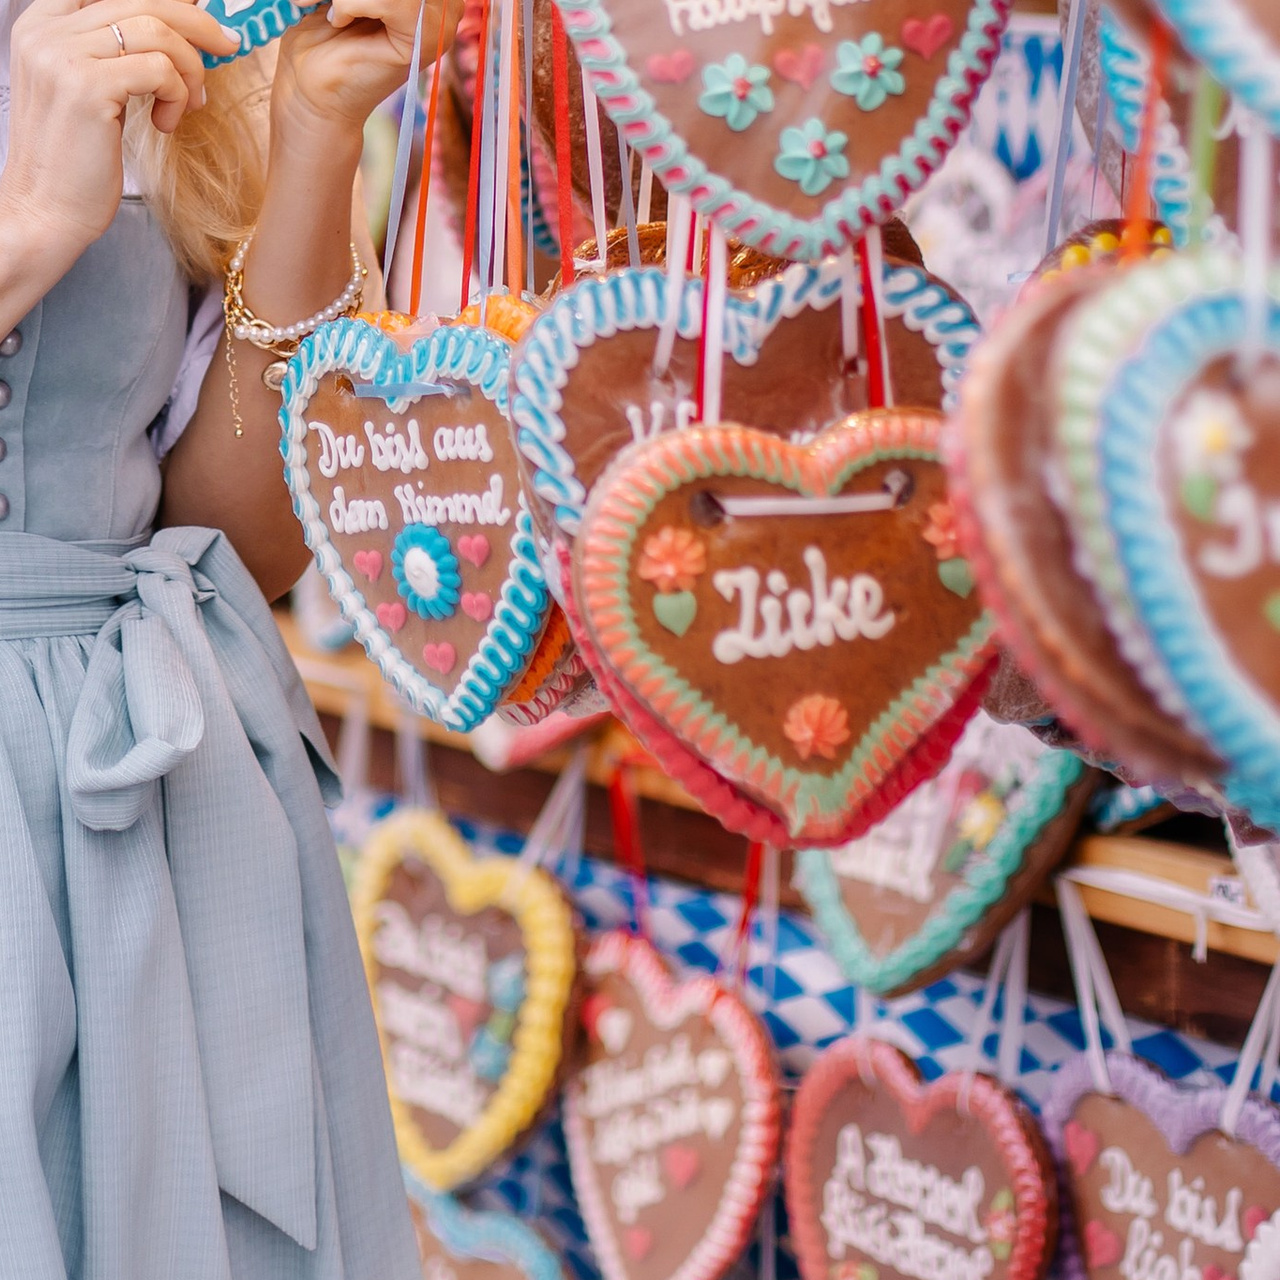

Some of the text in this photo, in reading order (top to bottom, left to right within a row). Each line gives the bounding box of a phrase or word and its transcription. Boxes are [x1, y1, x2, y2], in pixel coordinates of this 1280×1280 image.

[308, 418, 494, 479] Du bist aus
[329, 473, 512, 535] dem Himmel
[712, 545, 896, 664] Zicke
[1098, 1145, 1245, 1253] Du bist
